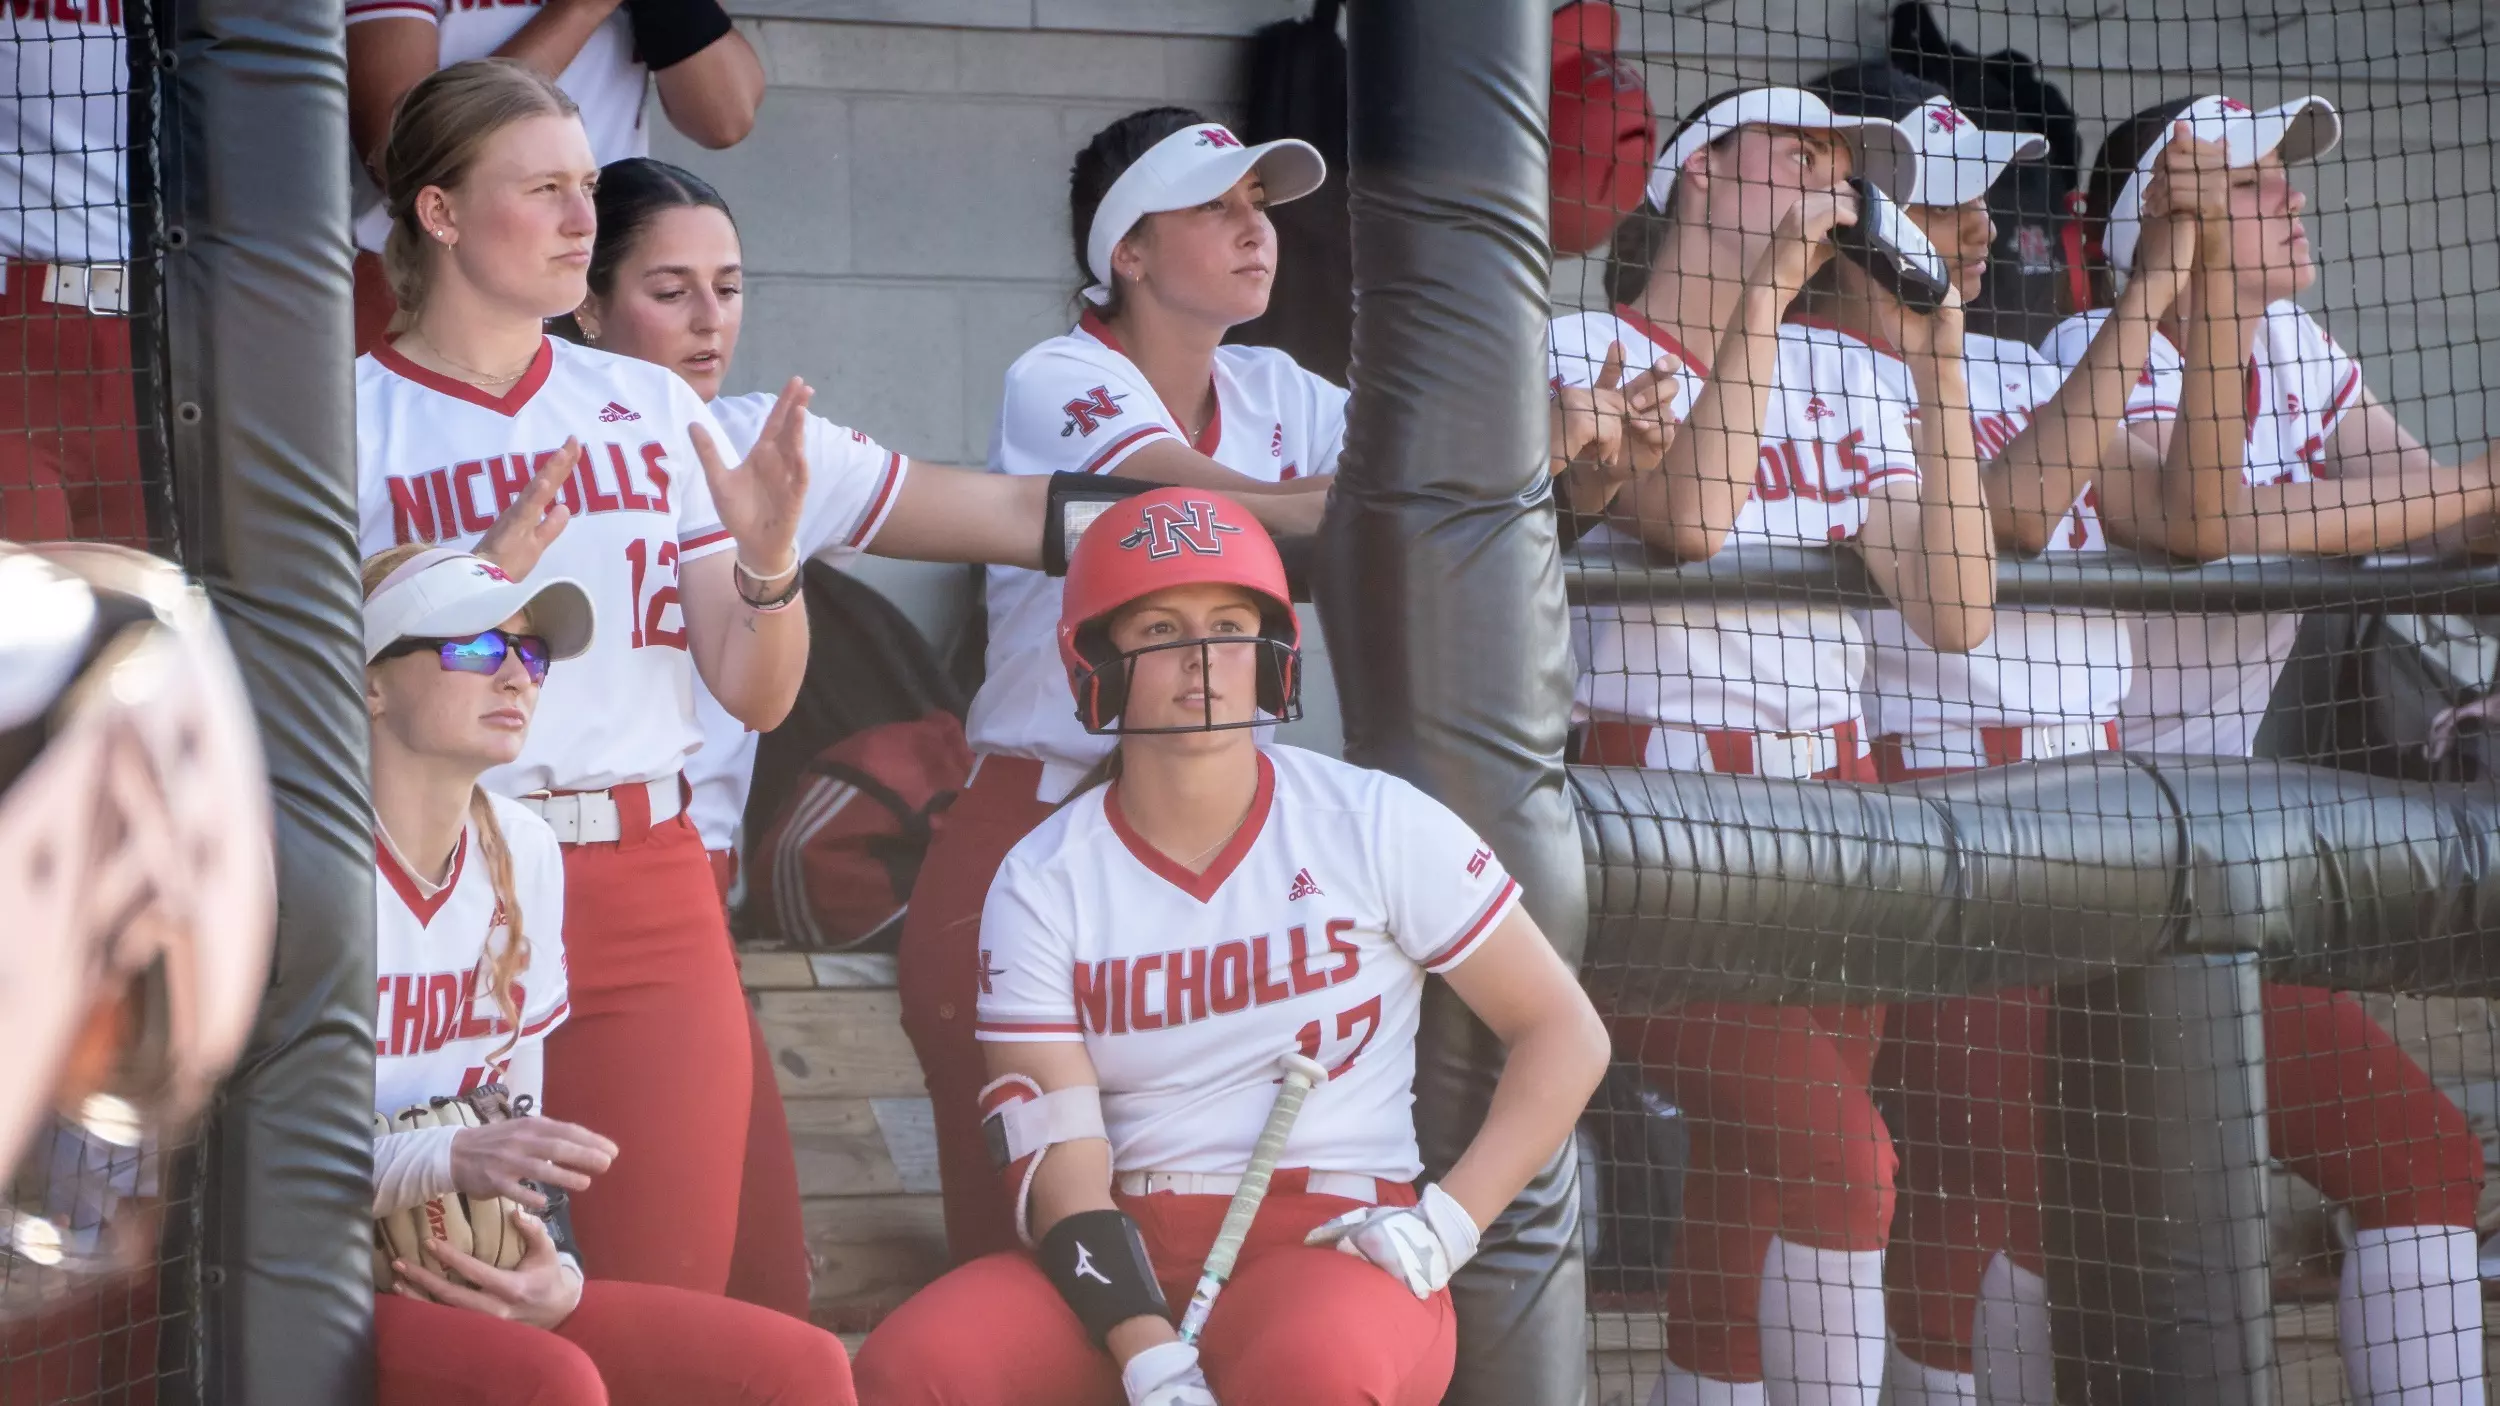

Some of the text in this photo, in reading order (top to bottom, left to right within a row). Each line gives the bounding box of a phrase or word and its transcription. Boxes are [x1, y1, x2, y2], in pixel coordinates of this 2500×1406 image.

[1062, 384, 1124, 438] N
[1747, 426, 1871, 504] OLLS
[1142, 500, 1222, 561] N
[624, 538, 688, 652] 12
[1466, 843, 1493, 880] SL
[1072, 917, 1362, 1037] NICHOLLS
